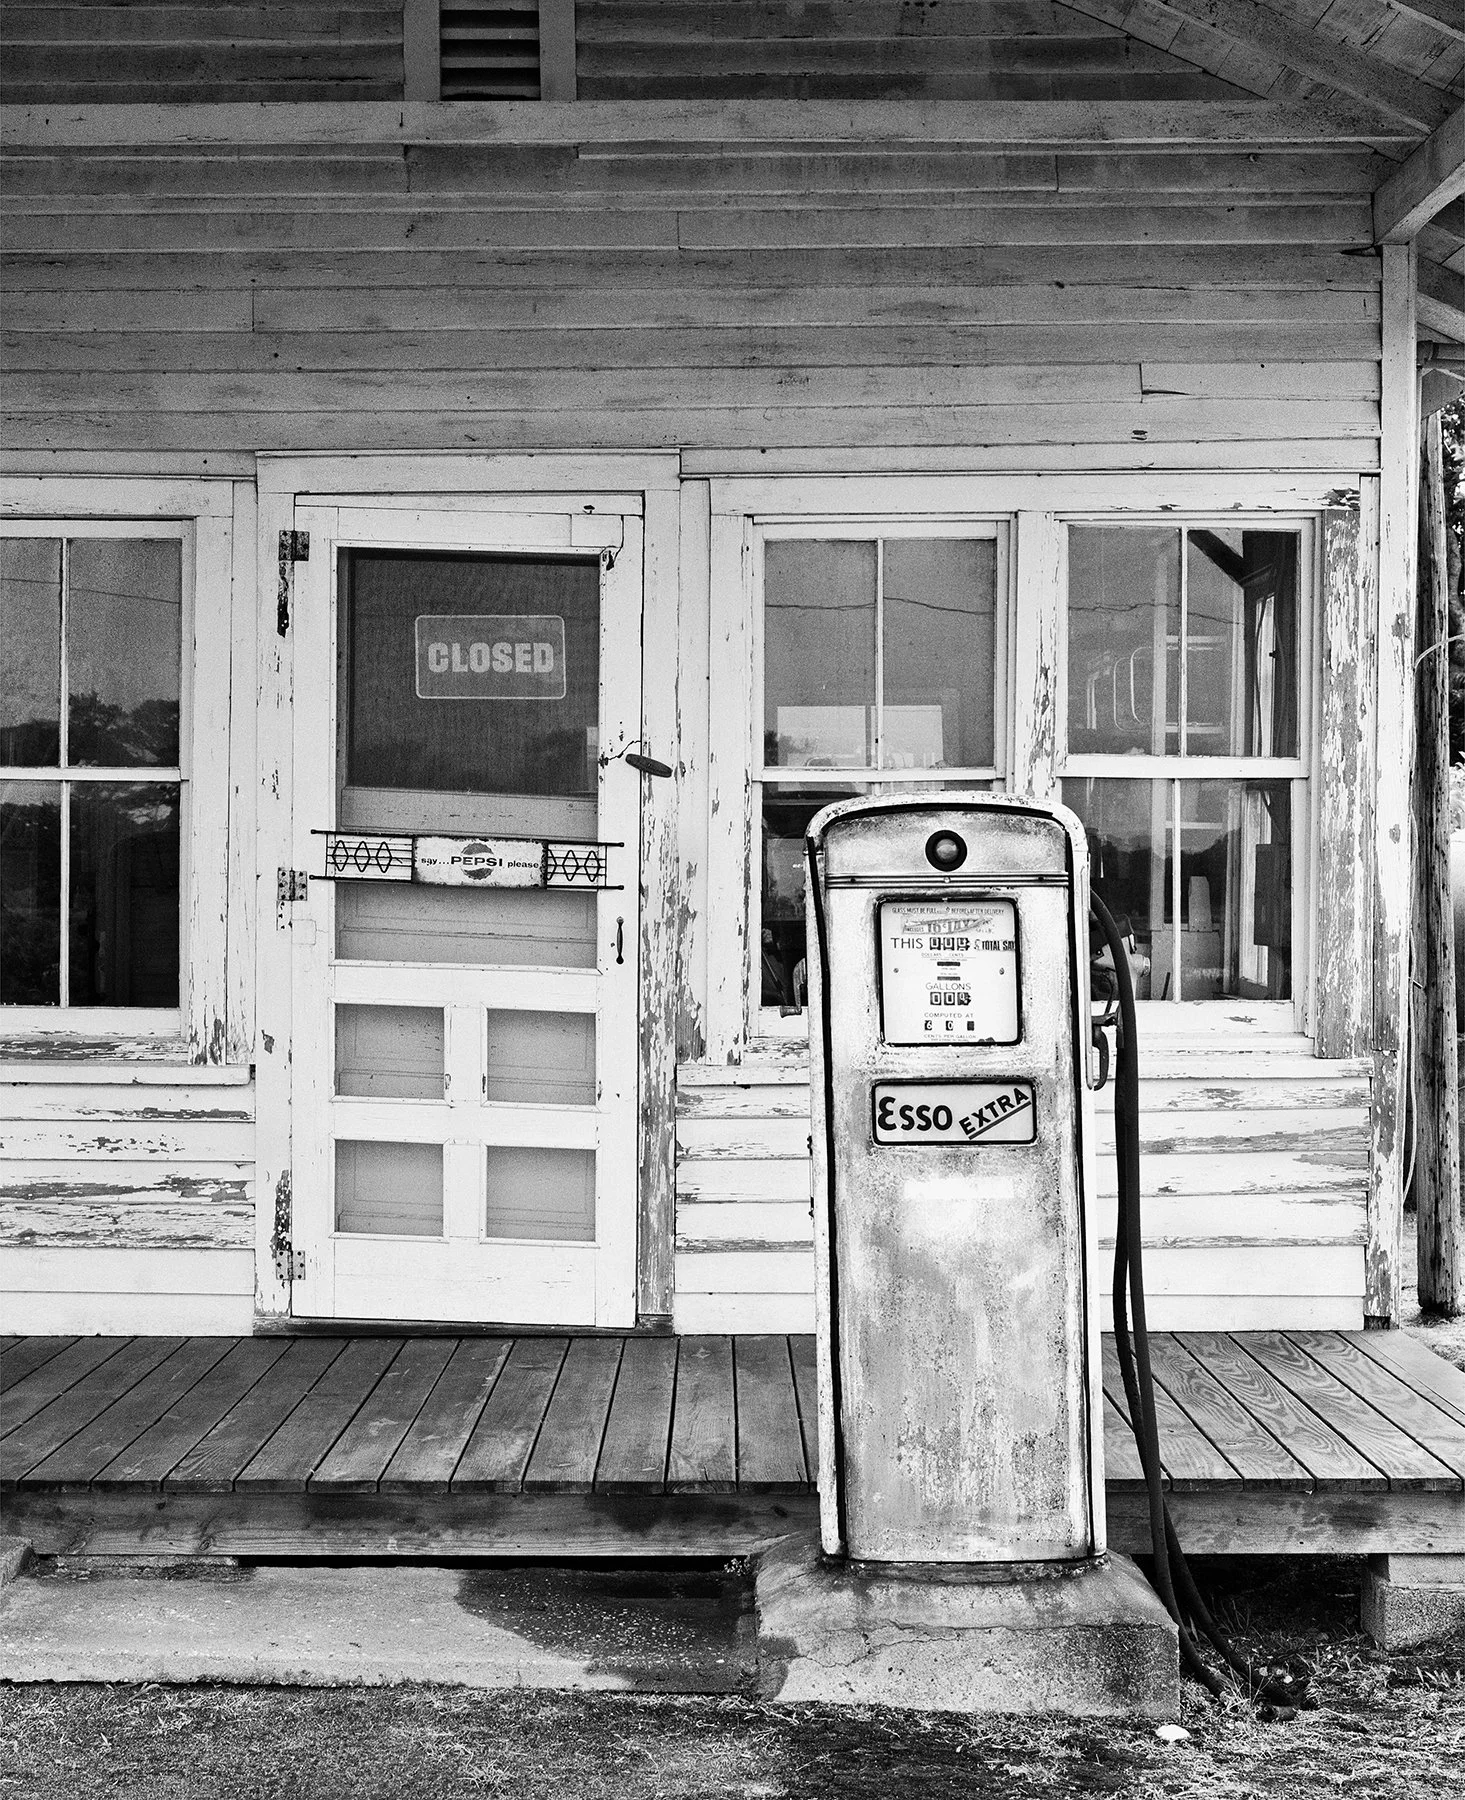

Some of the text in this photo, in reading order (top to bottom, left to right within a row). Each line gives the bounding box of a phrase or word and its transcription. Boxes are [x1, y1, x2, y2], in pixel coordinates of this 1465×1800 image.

[428, 642, 554, 673] CLOSED
[451, 856, 503, 867] PEPSI
[507, 860, 540, 869] please
[890, 937, 924, 950] THIS
[982, 940, 1001, 951] TOTAL
[925, 982, 972, 991] GALLONS
[958, 1087, 1030, 1136] EXTRA
